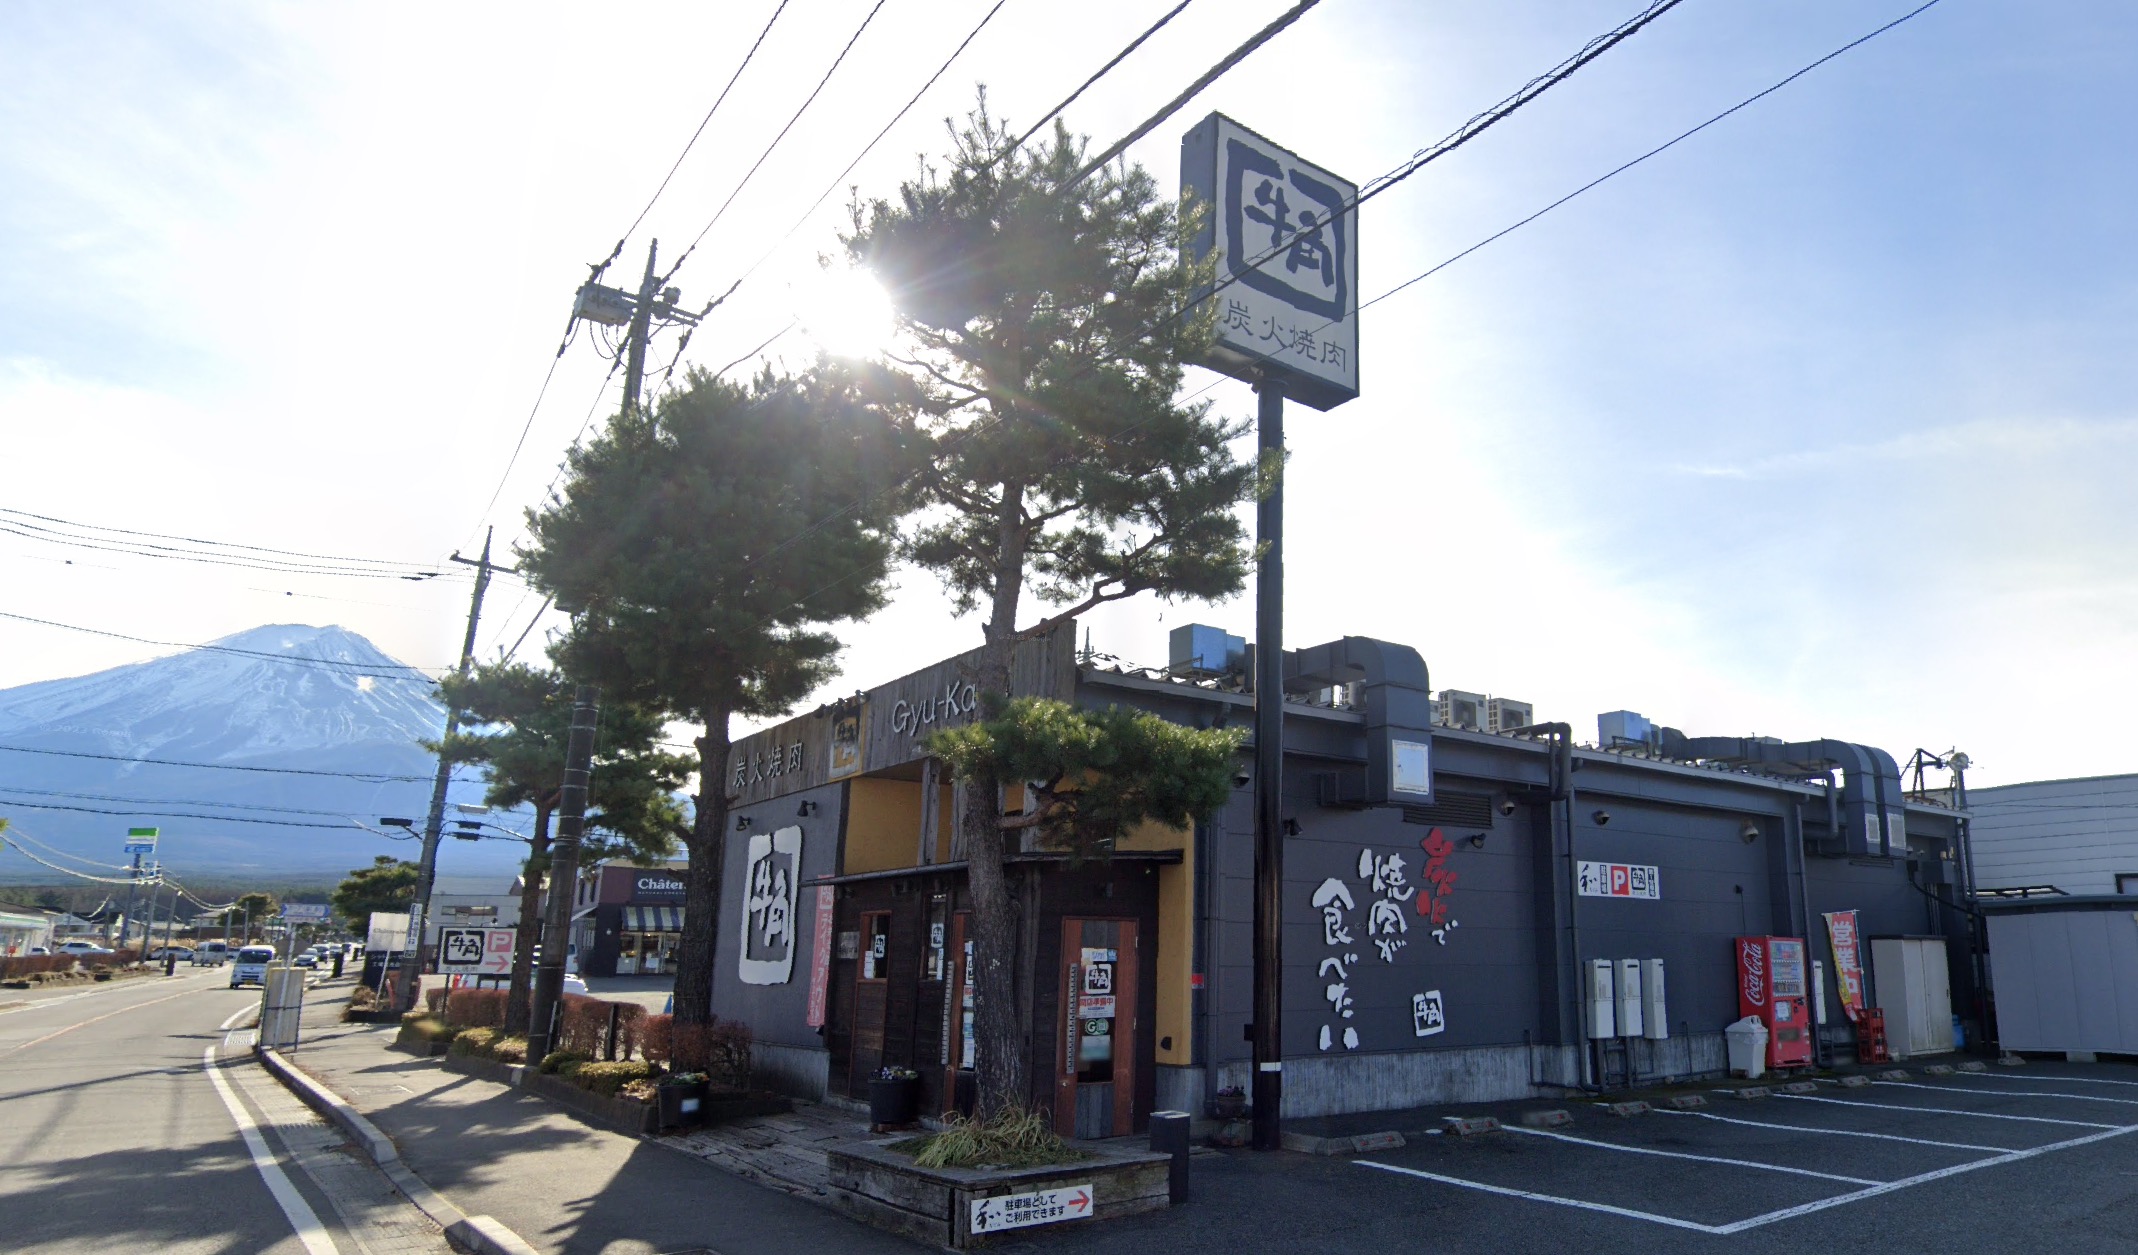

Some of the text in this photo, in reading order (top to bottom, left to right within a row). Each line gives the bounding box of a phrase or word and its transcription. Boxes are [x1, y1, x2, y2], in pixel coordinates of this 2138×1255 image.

[1223, 299, 1345, 372] 炭火焼肉
[732, 742, 803, 789] 炭火焼肉
[638, 878, 686, 890] Châter
[1613, 870, 1626, 891] P
[491, 934, 510, 951] P
[1312, 877, 1359, 1051] 食べたい
[1743, 940, 1765, 1006] Coca-Cola
[1005, 1194, 1057, 1211] 駐車場として
[1005, 1205, 1065, 1223] ご利用できます
